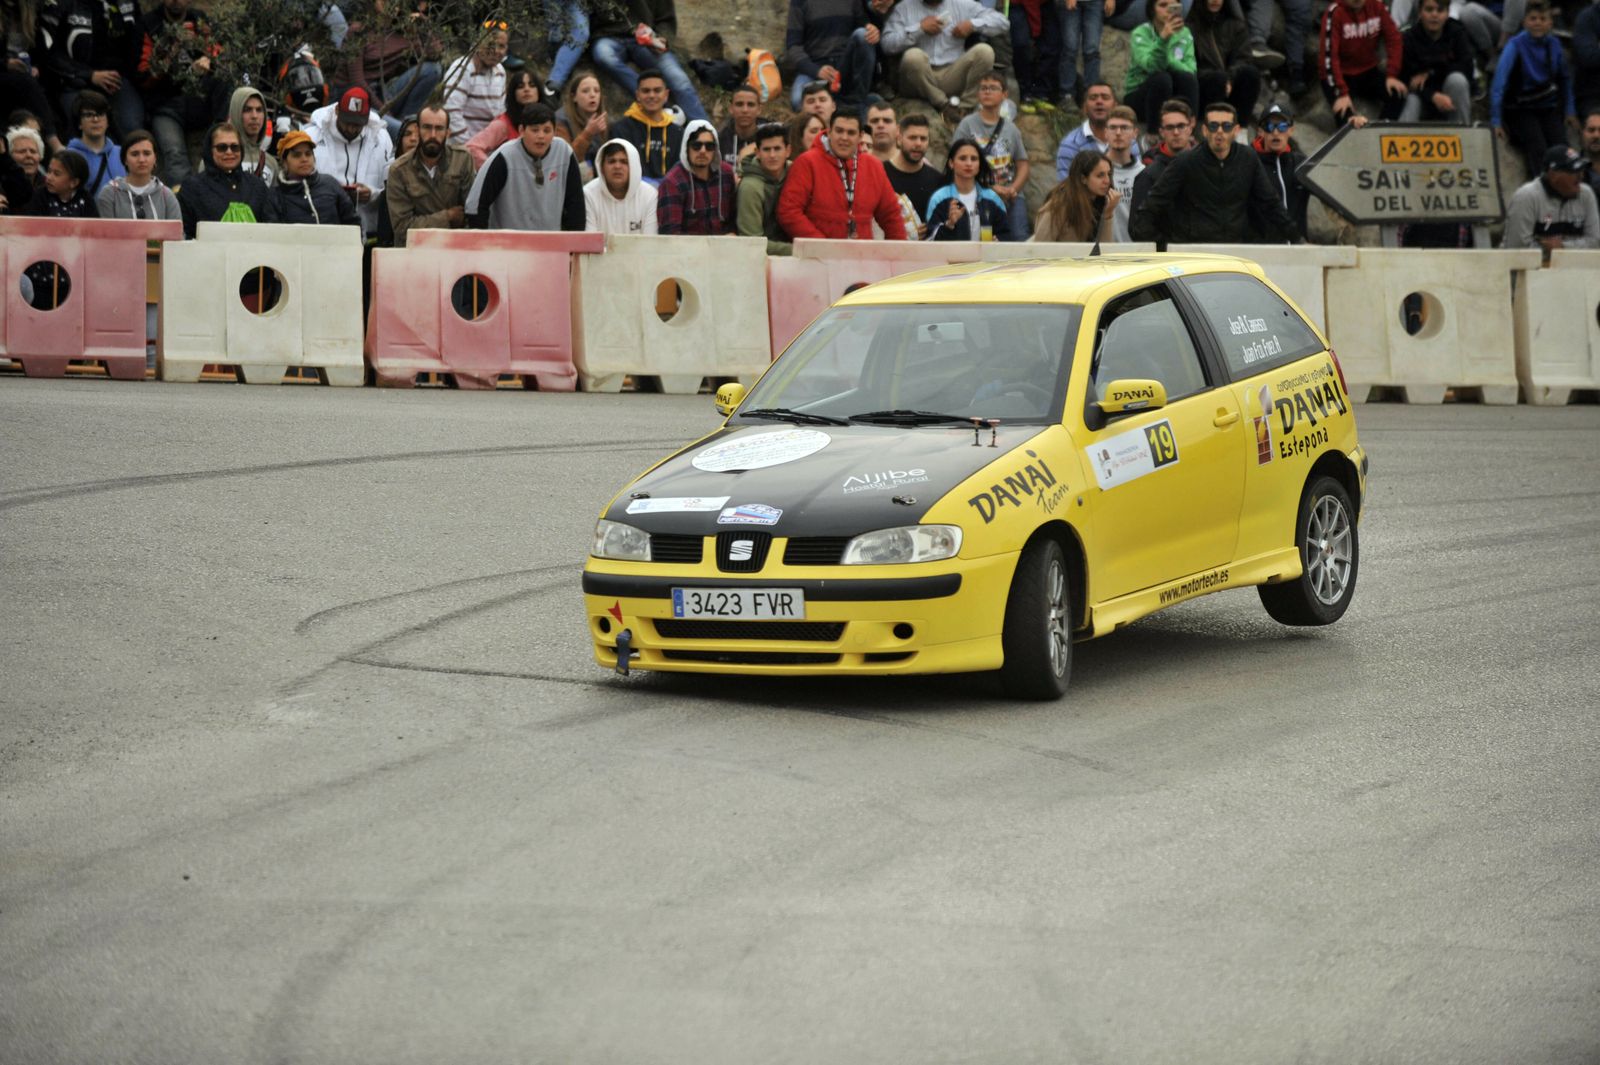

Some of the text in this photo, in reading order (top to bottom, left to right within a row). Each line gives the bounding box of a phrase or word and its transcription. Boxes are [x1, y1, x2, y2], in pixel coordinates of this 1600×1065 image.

[1386, 140, 1459, 158] A-2201
[1357, 169, 1411, 190] SAN
[1374, 195, 1479, 211] DEL VALLE
[1149, 425, 1174, 462] 19
[1280, 427, 1329, 458] Estepona
[1159, 569, 1229, 604] www.motortech.es
[691, 592, 794, 616] 3423 FVR
